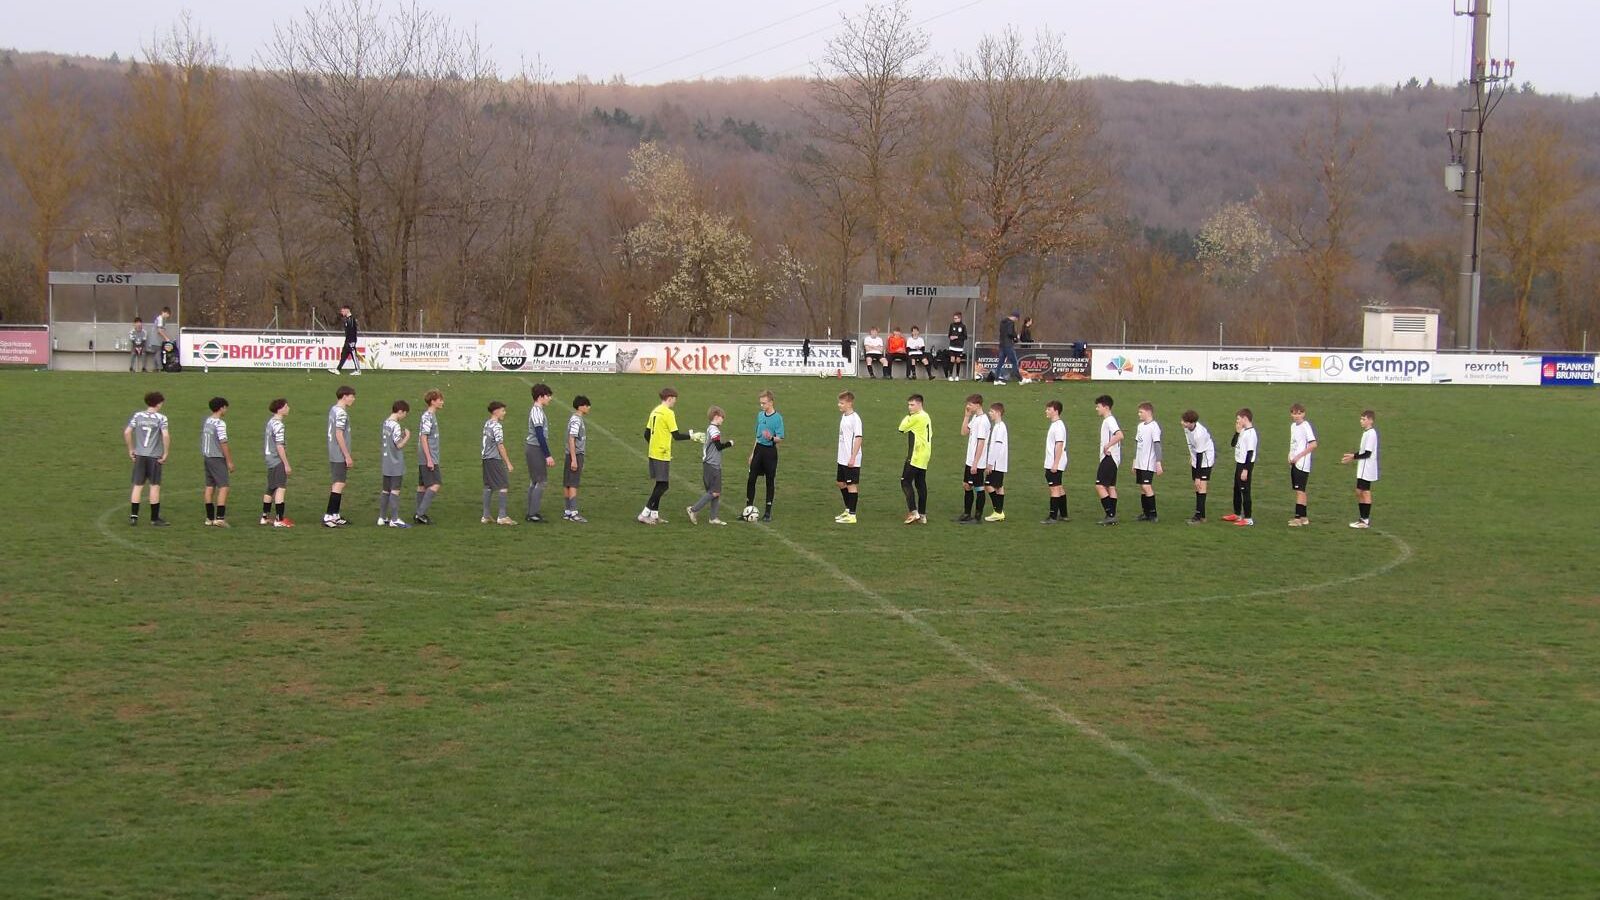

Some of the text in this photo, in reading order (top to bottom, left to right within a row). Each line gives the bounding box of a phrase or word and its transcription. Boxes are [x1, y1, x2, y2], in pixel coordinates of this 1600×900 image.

[96, 274, 132, 284] GAST
[906, 287, 937, 296] HEIM
[257, 337, 325, 345] hagebaumarkt
[229, 344, 316, 360] BAUSTOFF
[500, 347, 525, 356] SPORT
[533, 343, 608, 358] DILDEY
[502, 357, 523, 365] 2000
[664, 345, 731, 372] Keiler
[1020, 360, 1050, 369] FRANZ
[1212, 361, 1239, 370] brass
[1349, 355, 1430, 376] Grampp
[1465, 360, 1509, 371] rexroth
[1556, 363, 1594, 371] FRANKEN
[1138, 365, 1194, 375] Main-Echo
[1556, 371, 1594, 380] BRUNNEN
[142, 426, 152, 448] 7
